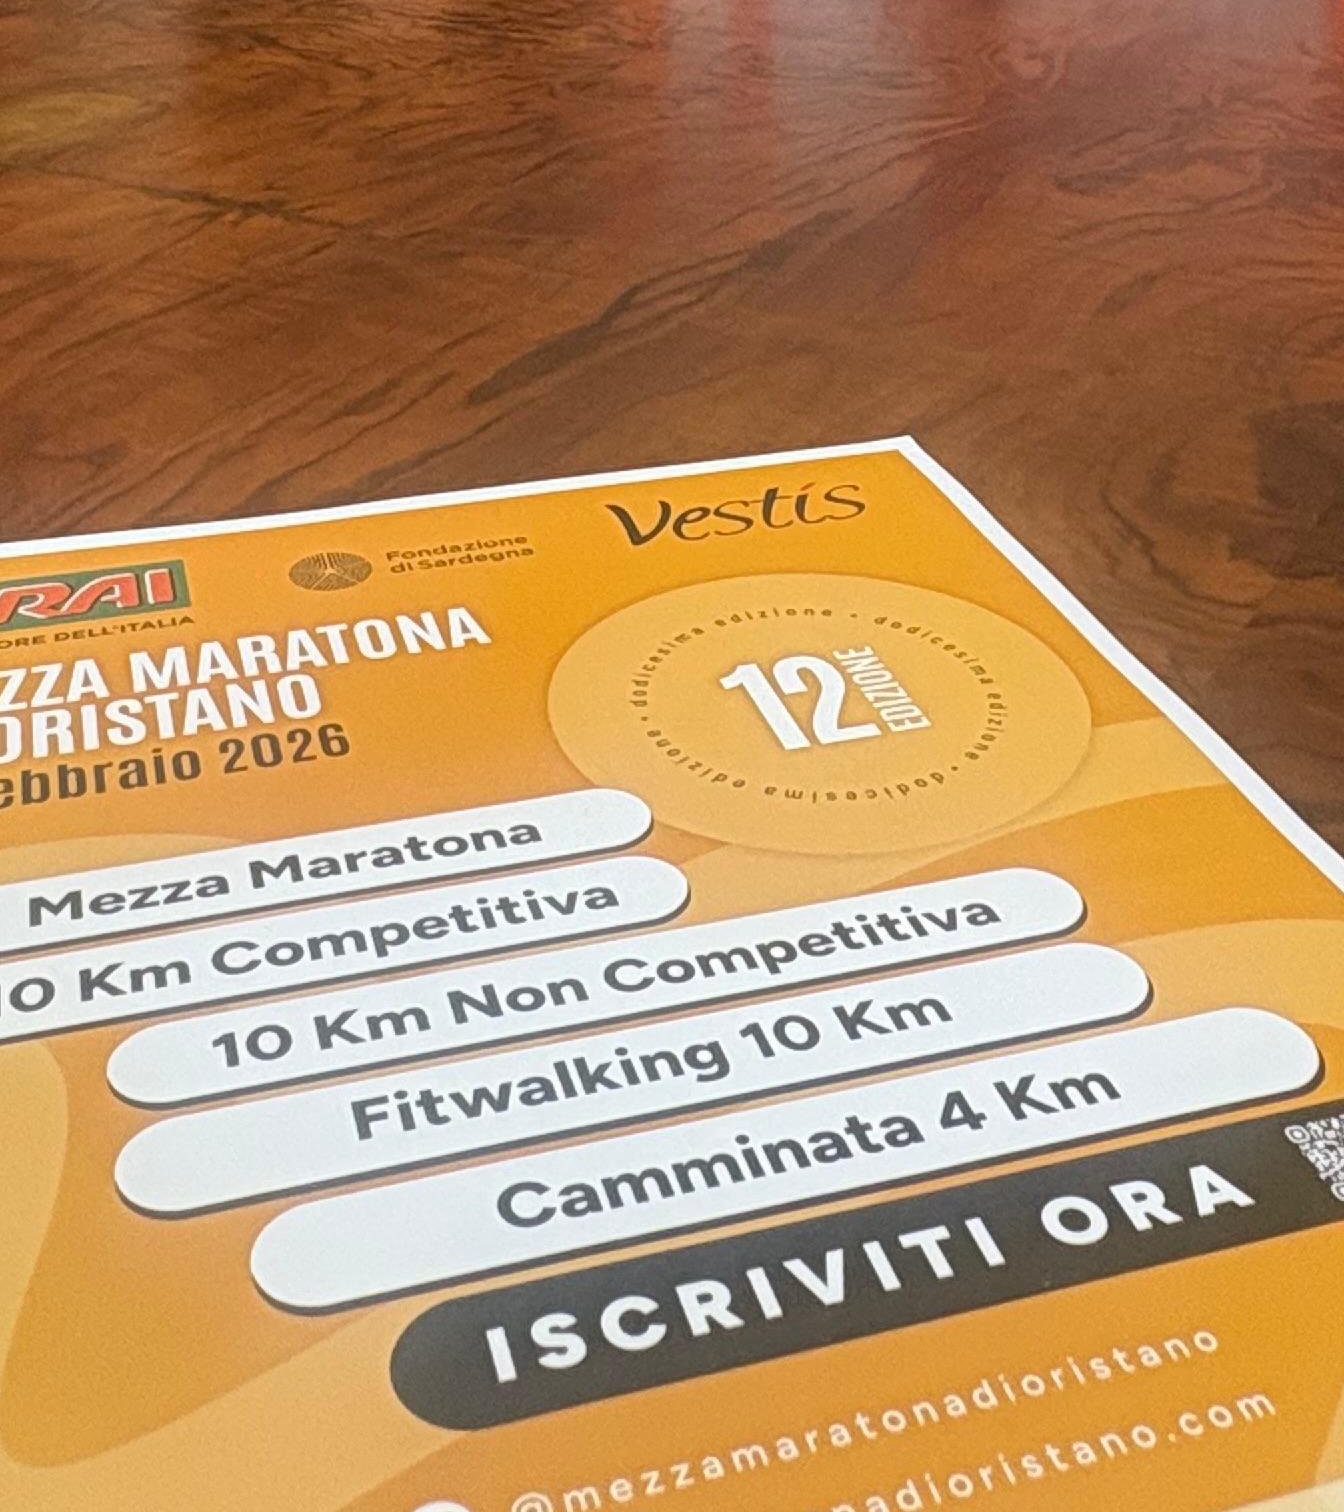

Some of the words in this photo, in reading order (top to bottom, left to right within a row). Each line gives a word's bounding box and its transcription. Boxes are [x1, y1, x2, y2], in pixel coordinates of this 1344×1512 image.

[386, 536, 528, 562] Fondazione
[606, 481, 867, 546] Vestis
[389, 561, 414, 574] di
[416, 547, 535, 570] Sardegna
[54, 615, 196, 644] DELL'ITALIA
[129, 605, 493, 692] MARATONA
[714, 607, 833, 628] edizione
[873, 615, 995, 685] dodicesima
[718, 654, 882, 751] 12
[832, 645, 933, 733] EDIZIONE
[220, 722, 352, 776] 2026
[27, 872, 230, 929] Mezza
[248, 819, 543, 891] Maratona
[79, 959, 192, 1003] Km
[210, 880, 621, 975] Competitiva
[211, 1022, 294, 1070] 10
[313, 1005, 432, 1051] Km
[449, 974, 589, 1026] Non
[602, 896, 1002, 996] Competitiva
[350, 1033, 730, 1141] Fitwalking
[740, 1014, 822, 1060] 10
[843, 988, 954, 1039] Km
[494, 1104, 926, 1232] Camminata
[937, 1088, 989, 1136] 4
[1008, 1063, 1122, 1123] Km
[484, 1213, 1009, 1386] ISCRIVITI
[1038, 1161, 1257, 1250] ORA
